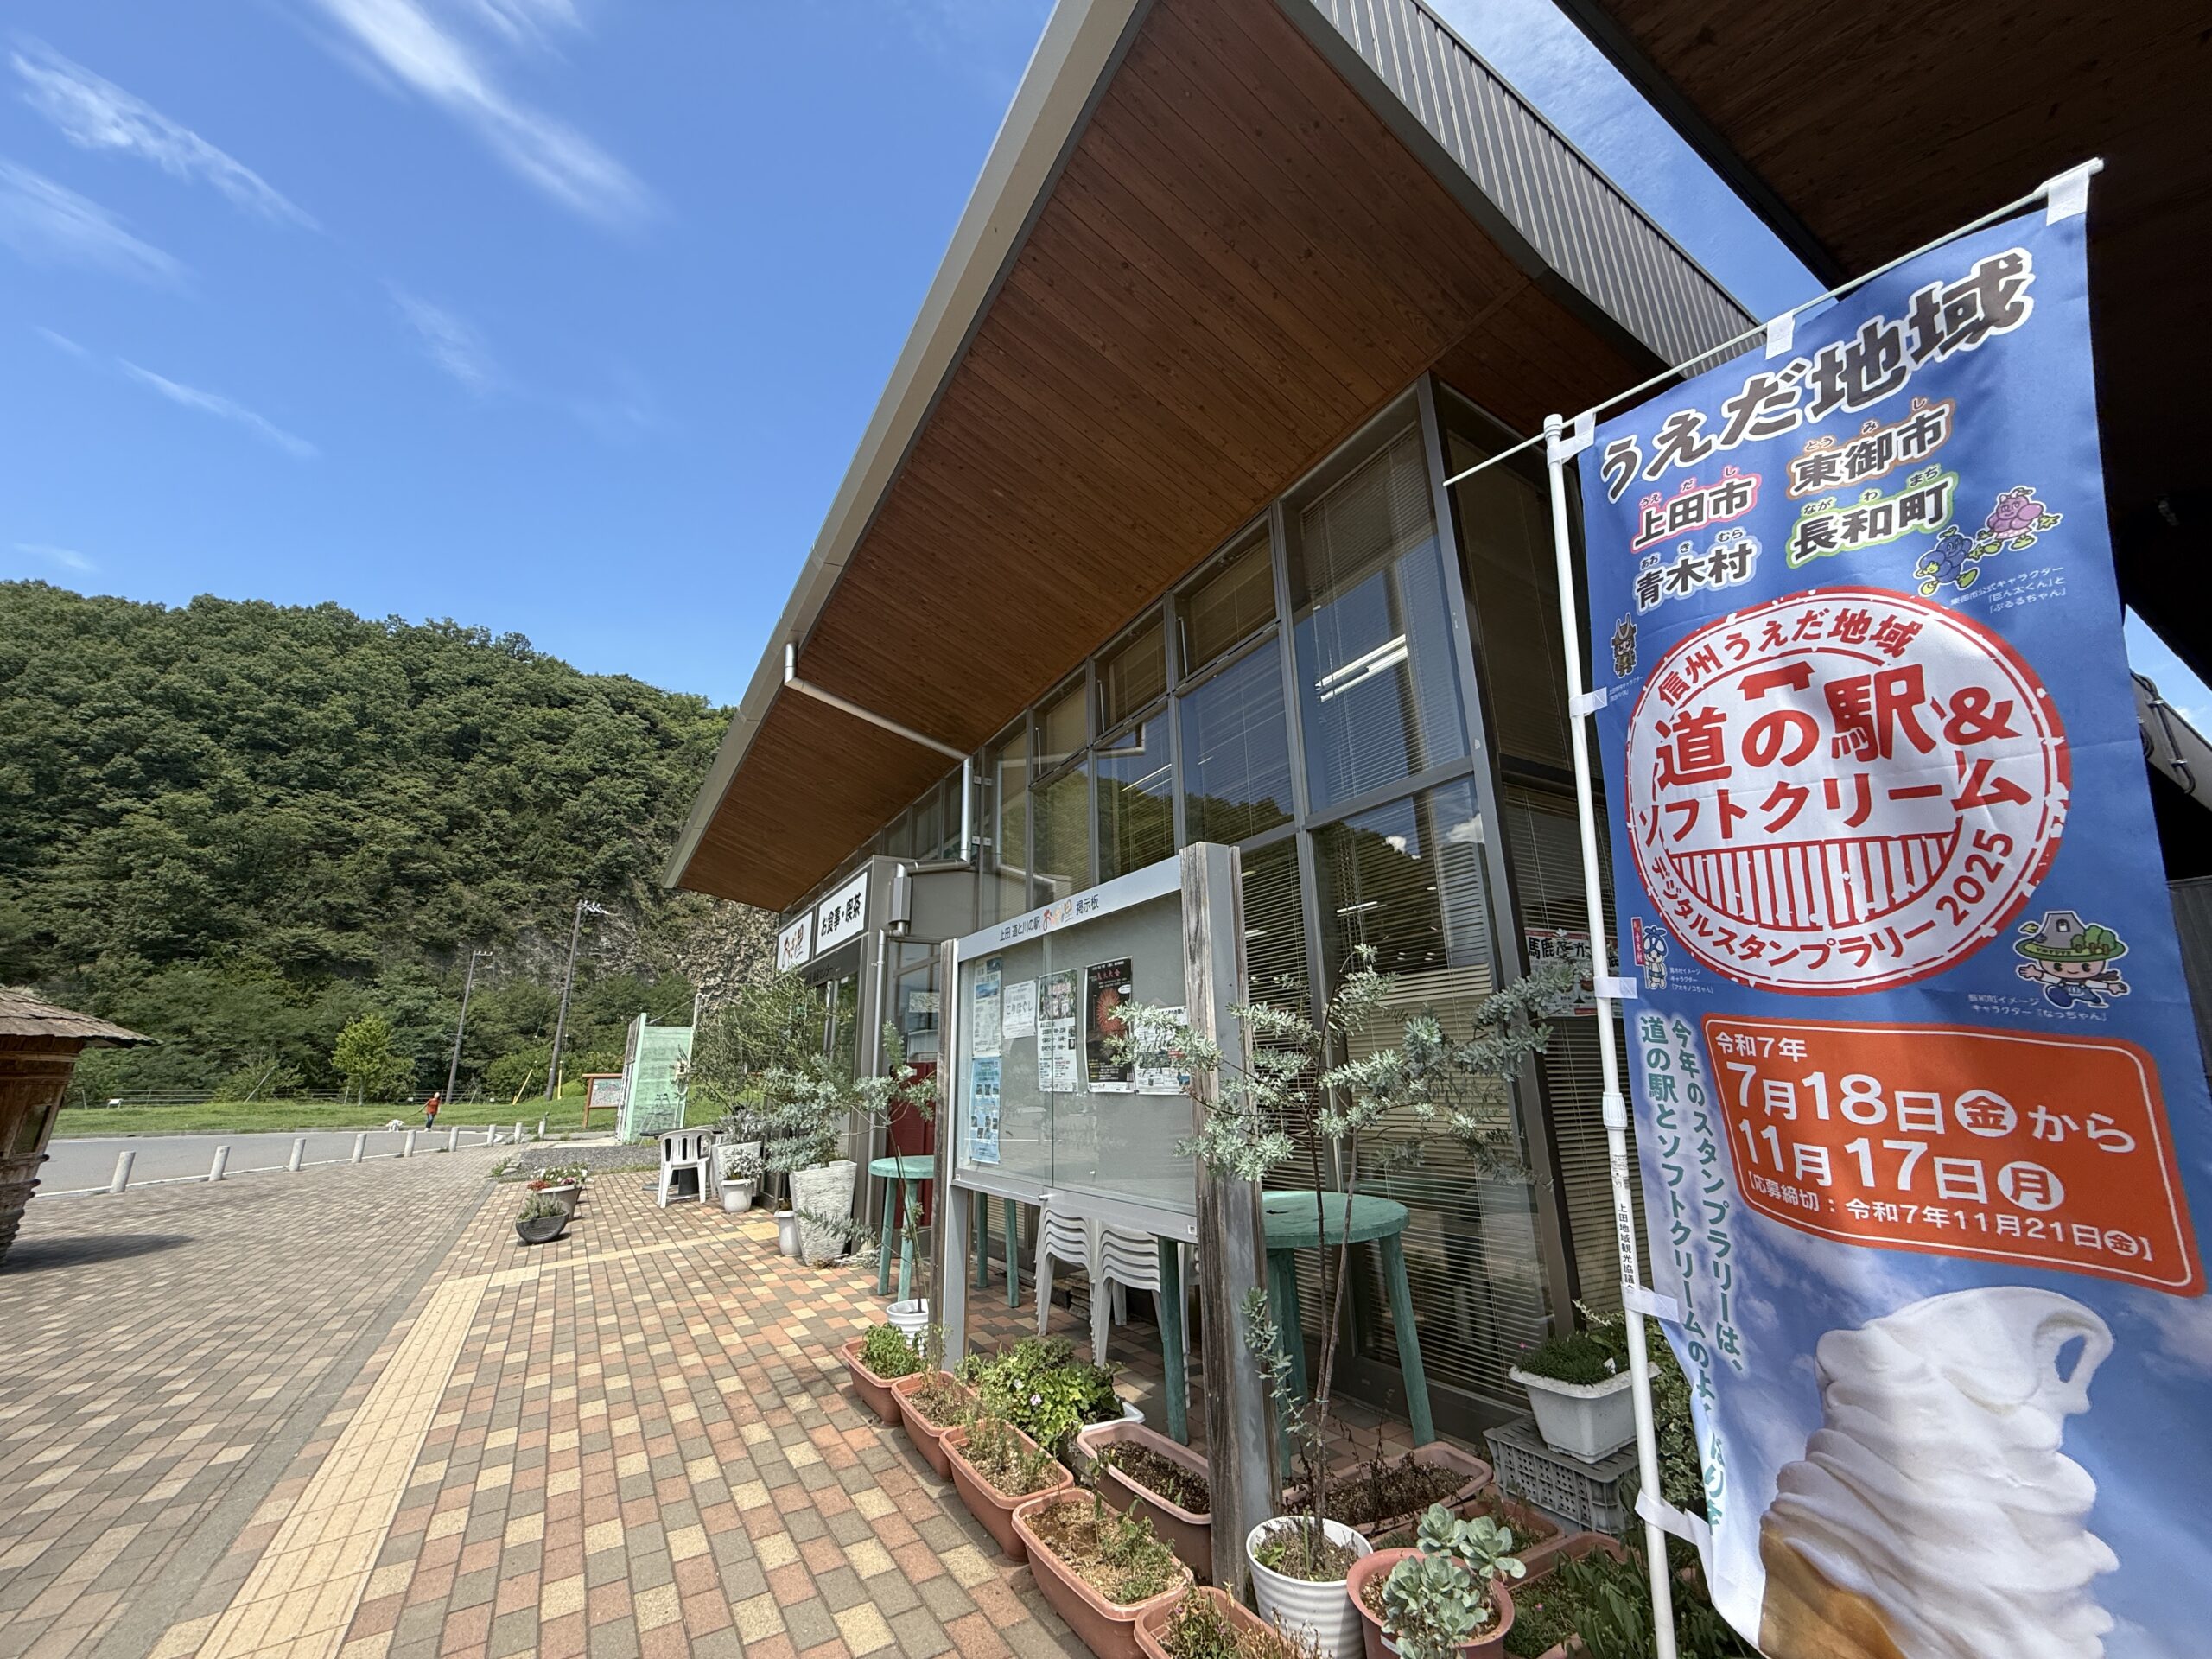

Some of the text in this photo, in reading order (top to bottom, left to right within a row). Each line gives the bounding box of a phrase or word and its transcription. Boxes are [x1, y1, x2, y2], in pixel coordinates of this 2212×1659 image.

[1603, 250, 2031, 501] うえだ地域
[1795, 409, 1945, 493] 東御市
[1806, 399, 1925, 450] とう み し
[1635, 474, 1752, 547] 上田市
[1641, 493, 1661, 507] うえ
[1681, 479, 1694, 492] だ
[1794, 481, 1948, 561] 長和町
[1803, 467, 1939, 514] なが わ まち
[1637, 543, 1752, 608] 青木村
[1641, 555, 1659, 569] あお
[1718, 529, 1744, 543] むら
[1658, 608, 1923, 708] 信州うえだ地域
[1655, 663, 2024, 791] 道の駅&
[1640, 752, 2033, 849] ソフトクリーム
[999, 926, 1011, 941] 上田
[1076, 894, 1099, 915] 掲示板
[1715, 1032, 1808, 1062] 令和7年
[1671, 1019, 1743, 1370] 今年のスタンプラリーは、
